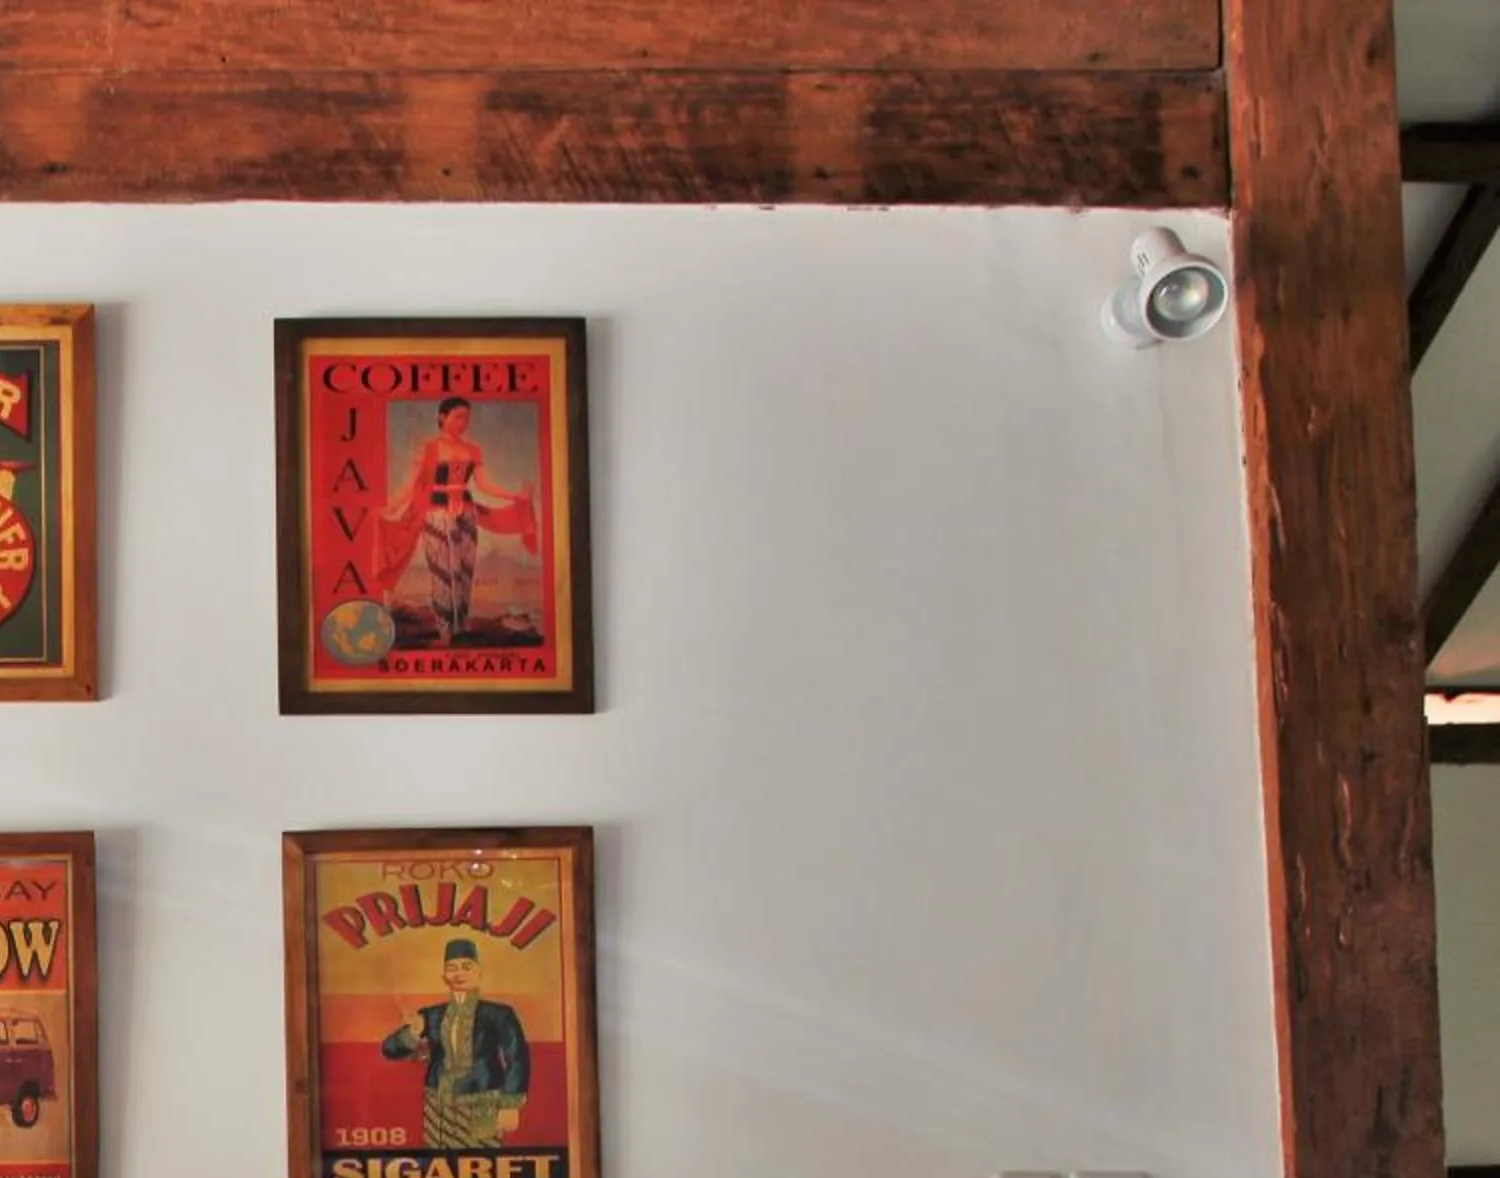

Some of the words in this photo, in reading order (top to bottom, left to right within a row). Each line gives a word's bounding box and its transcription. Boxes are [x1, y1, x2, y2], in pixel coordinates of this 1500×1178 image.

[322, 362, 539, 394] COFFEE
[331, 406, 369, 595] JAVA
[377, 657, 546, 674] SOERAKARTA
[322, 882, 558, 950] PRIJAJI
[336, 1127, 407, 1146] 1908
